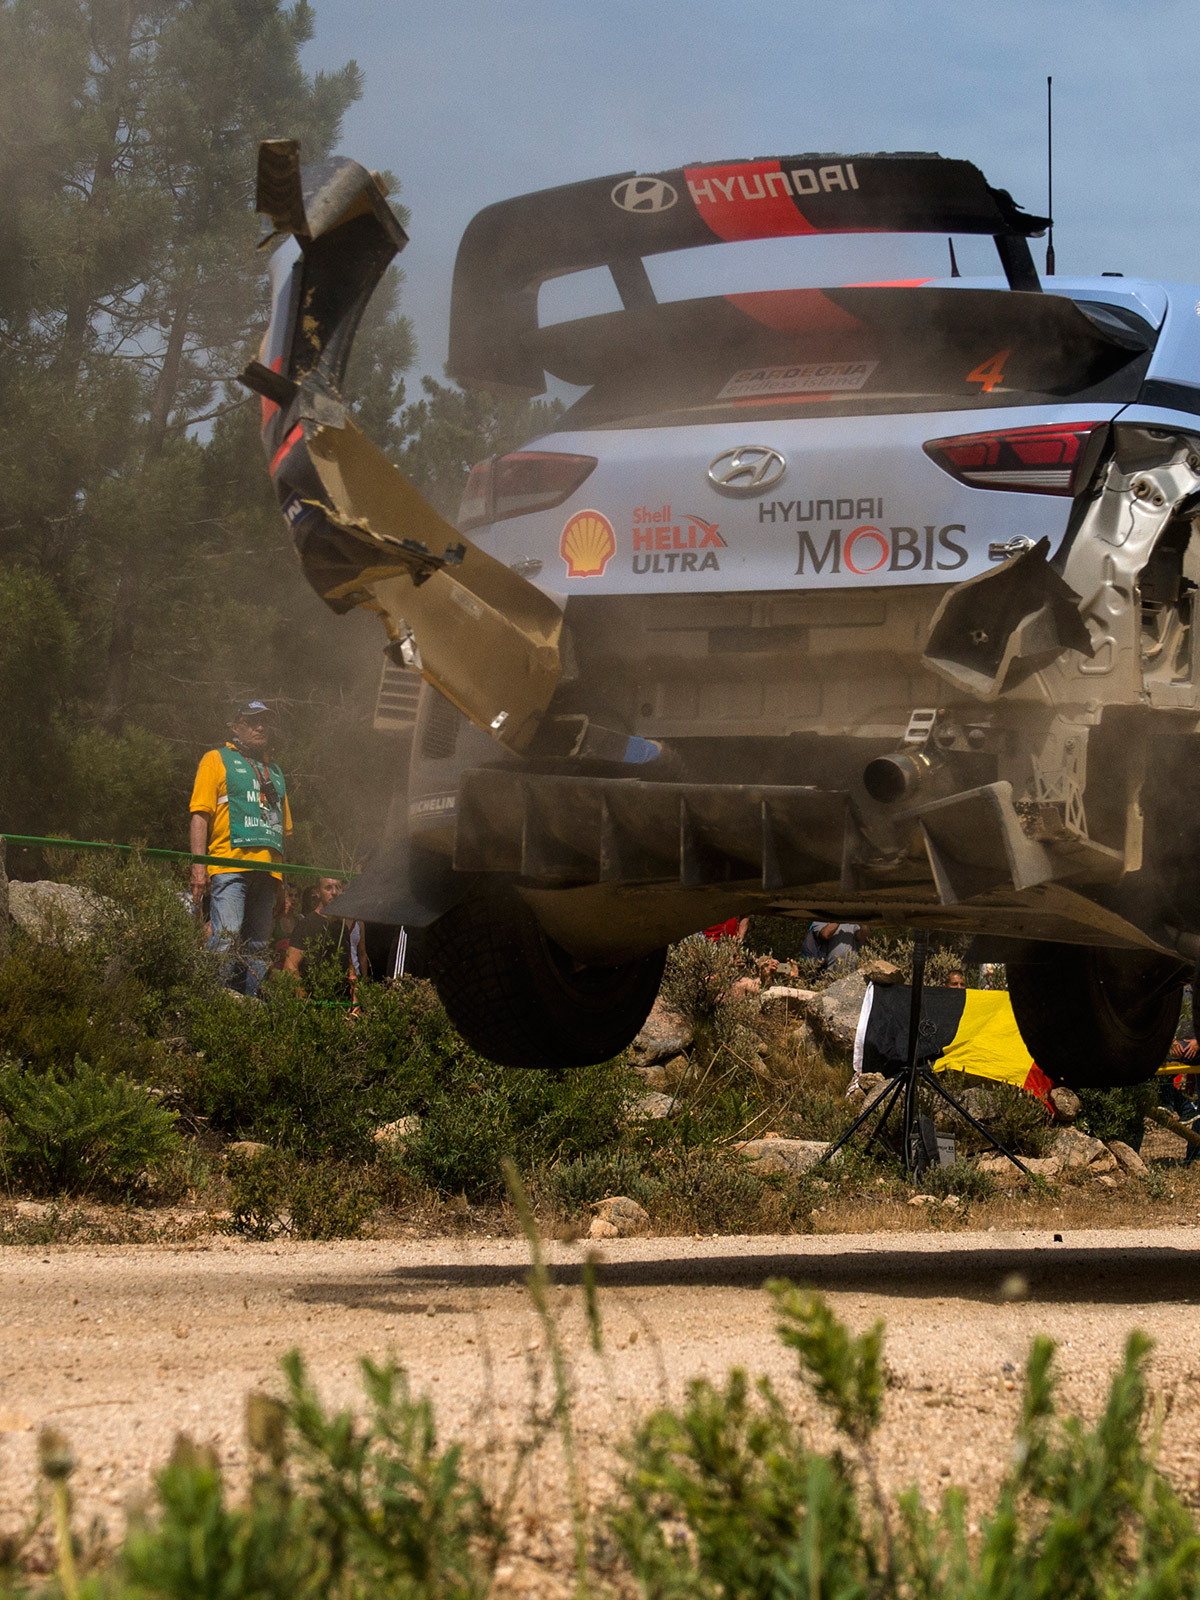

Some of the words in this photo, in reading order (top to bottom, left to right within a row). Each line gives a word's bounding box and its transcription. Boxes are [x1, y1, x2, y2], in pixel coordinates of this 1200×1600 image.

[688, 163, 859, 204] HYUNDAI
[735, 364, 867, 383] SARDEGNA
[966, 348, 1011, 392] 4
[728, 376, 797, 394] endless
[802, 374, 863, 389] island
[632, 505, 671, 524] Shell
[759, 498, 883, 523] HYUNDAI
[632, 522, 728, 551] HELIX
[794, 523, 969, 575] MOBIS
[632, 551, 720, 575] ULTRA
